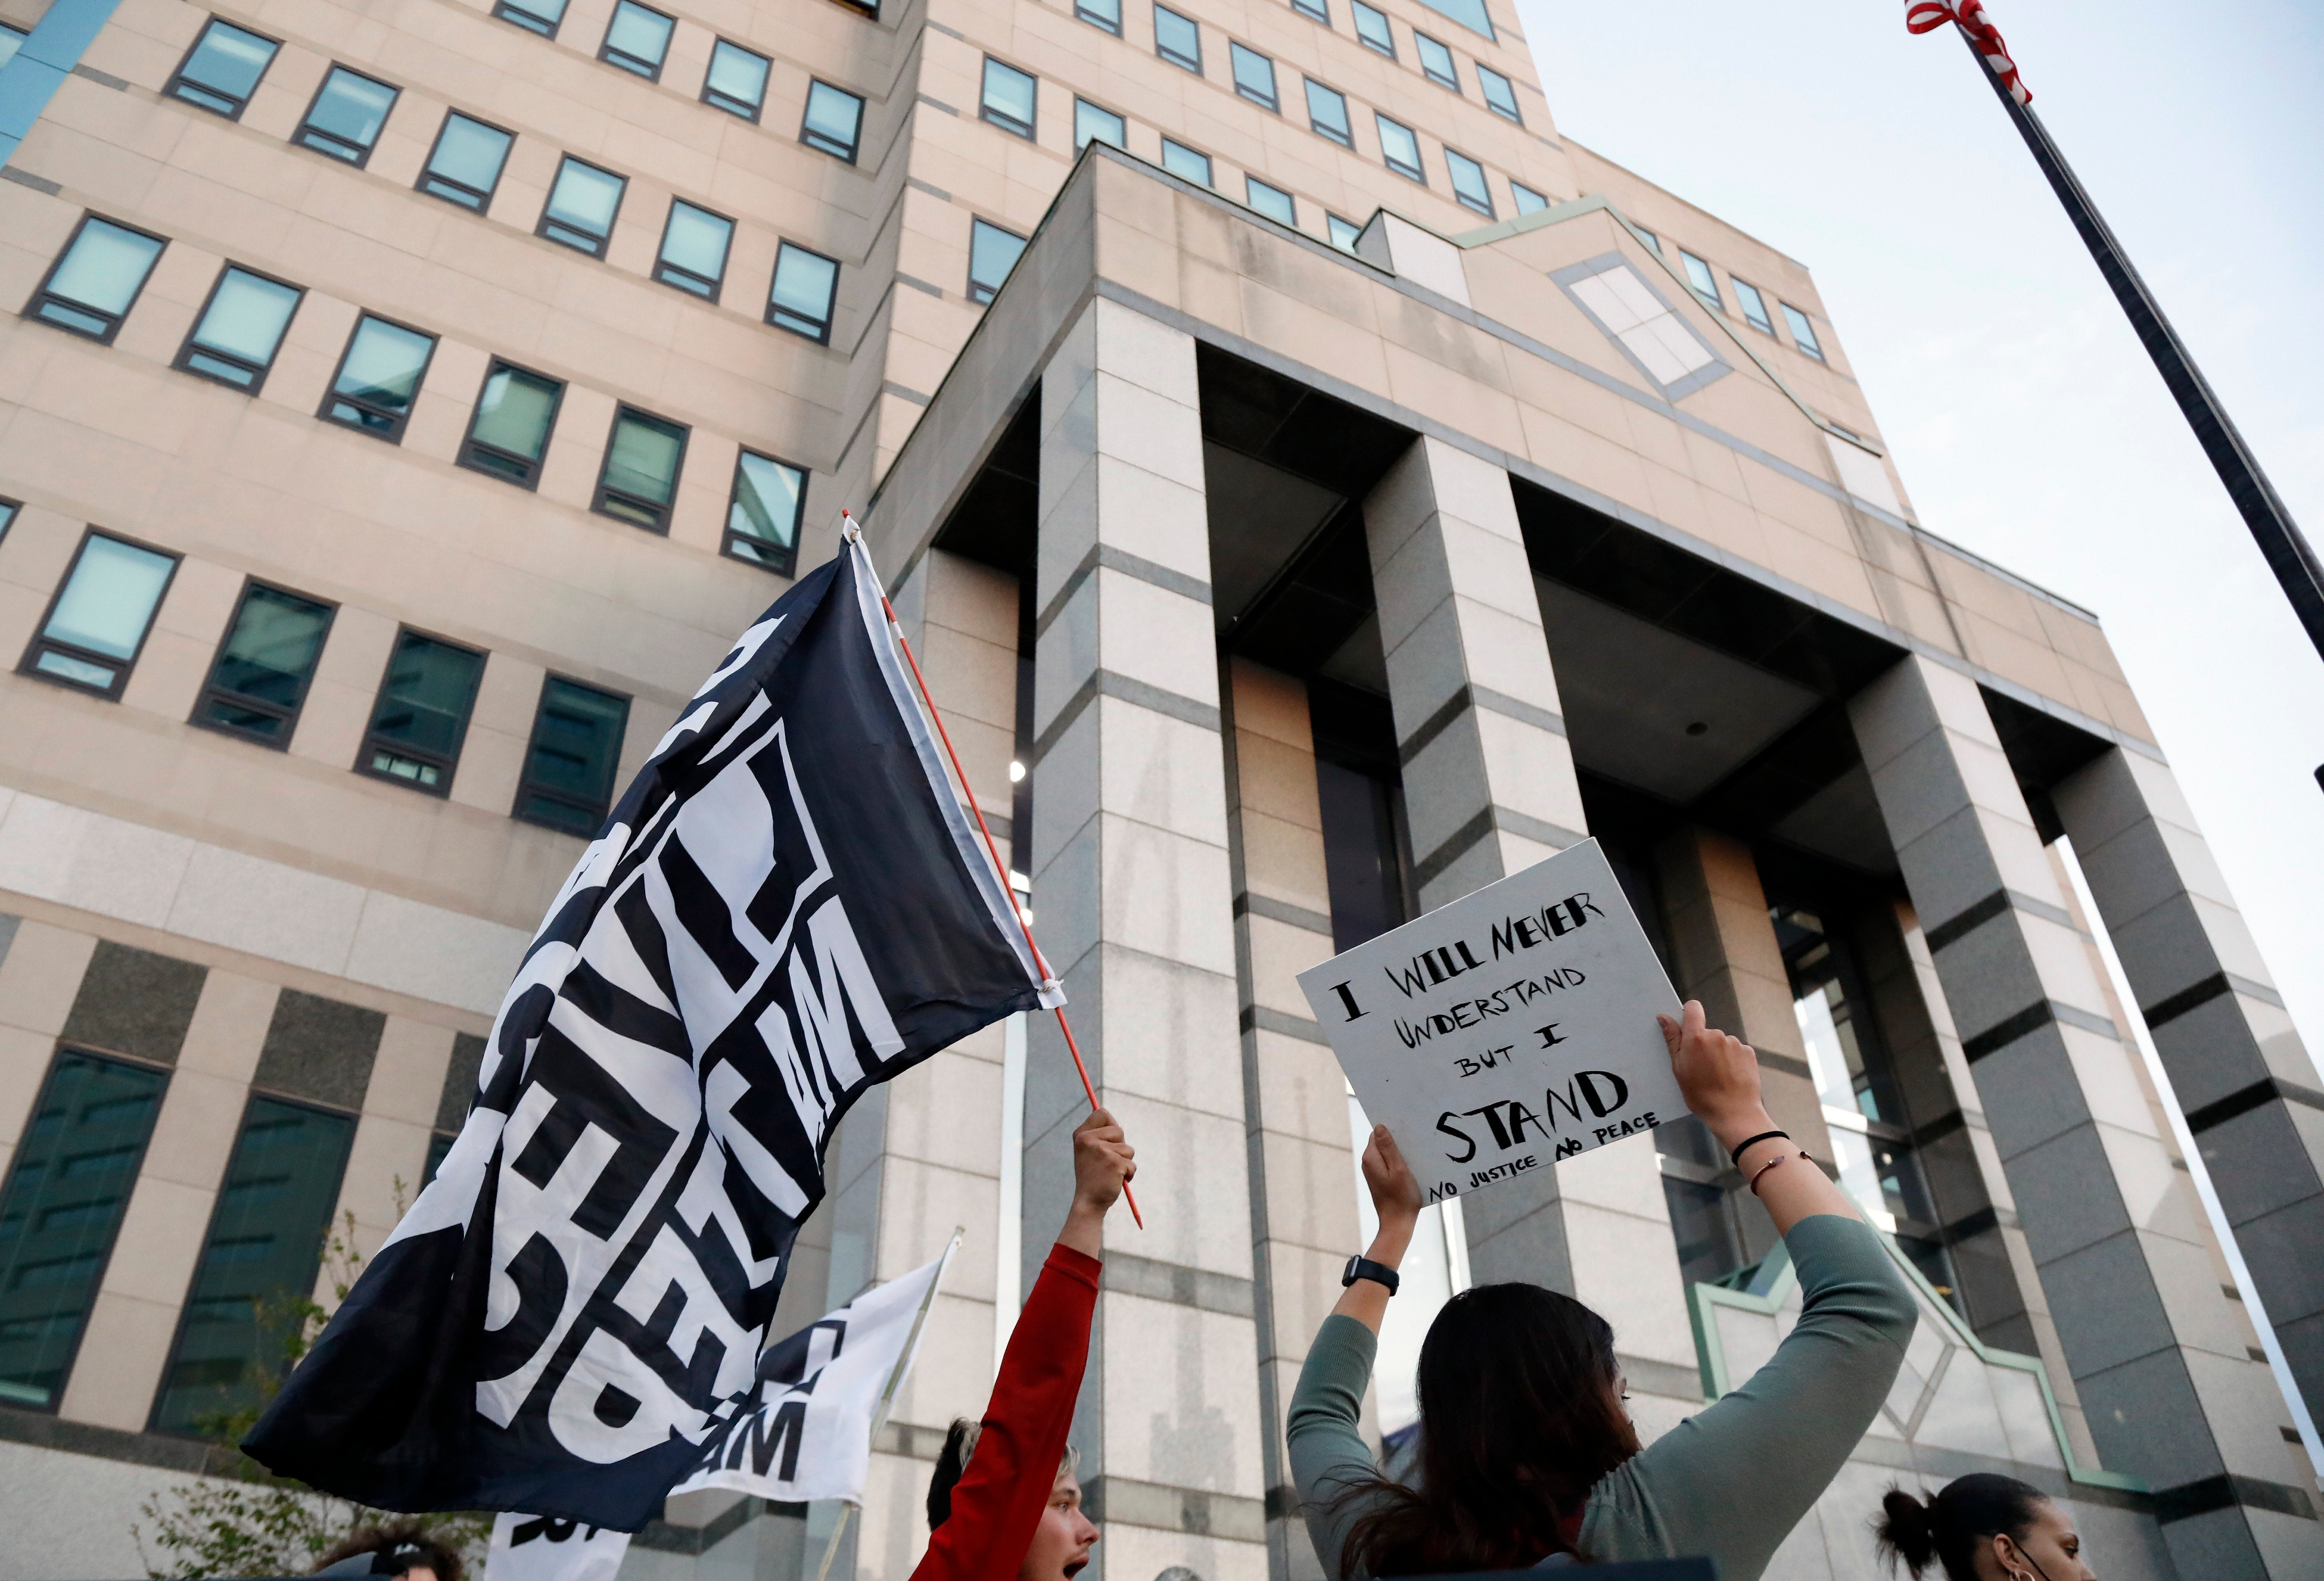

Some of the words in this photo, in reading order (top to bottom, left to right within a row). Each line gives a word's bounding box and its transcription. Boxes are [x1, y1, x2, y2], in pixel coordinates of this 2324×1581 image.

[1329, 980, 1370, 1022] I
[1385, 940, 1487, 999] WILL
[1492, 893, 1605, 961] NEVER
[1395, 968, 1586, 1048] UNDERSTAND
[1454, 1045, 1512, 1077] BUT
[1533, 1023, 1568, 1049] I
[1430, 1181, 1457, 1203] NO
[1470, 1156, 1537, 1188] JUSTICE
[1592, 1112, 1660, 1145] PEACE
[1436, 1071, 1628, 1163] STAND
